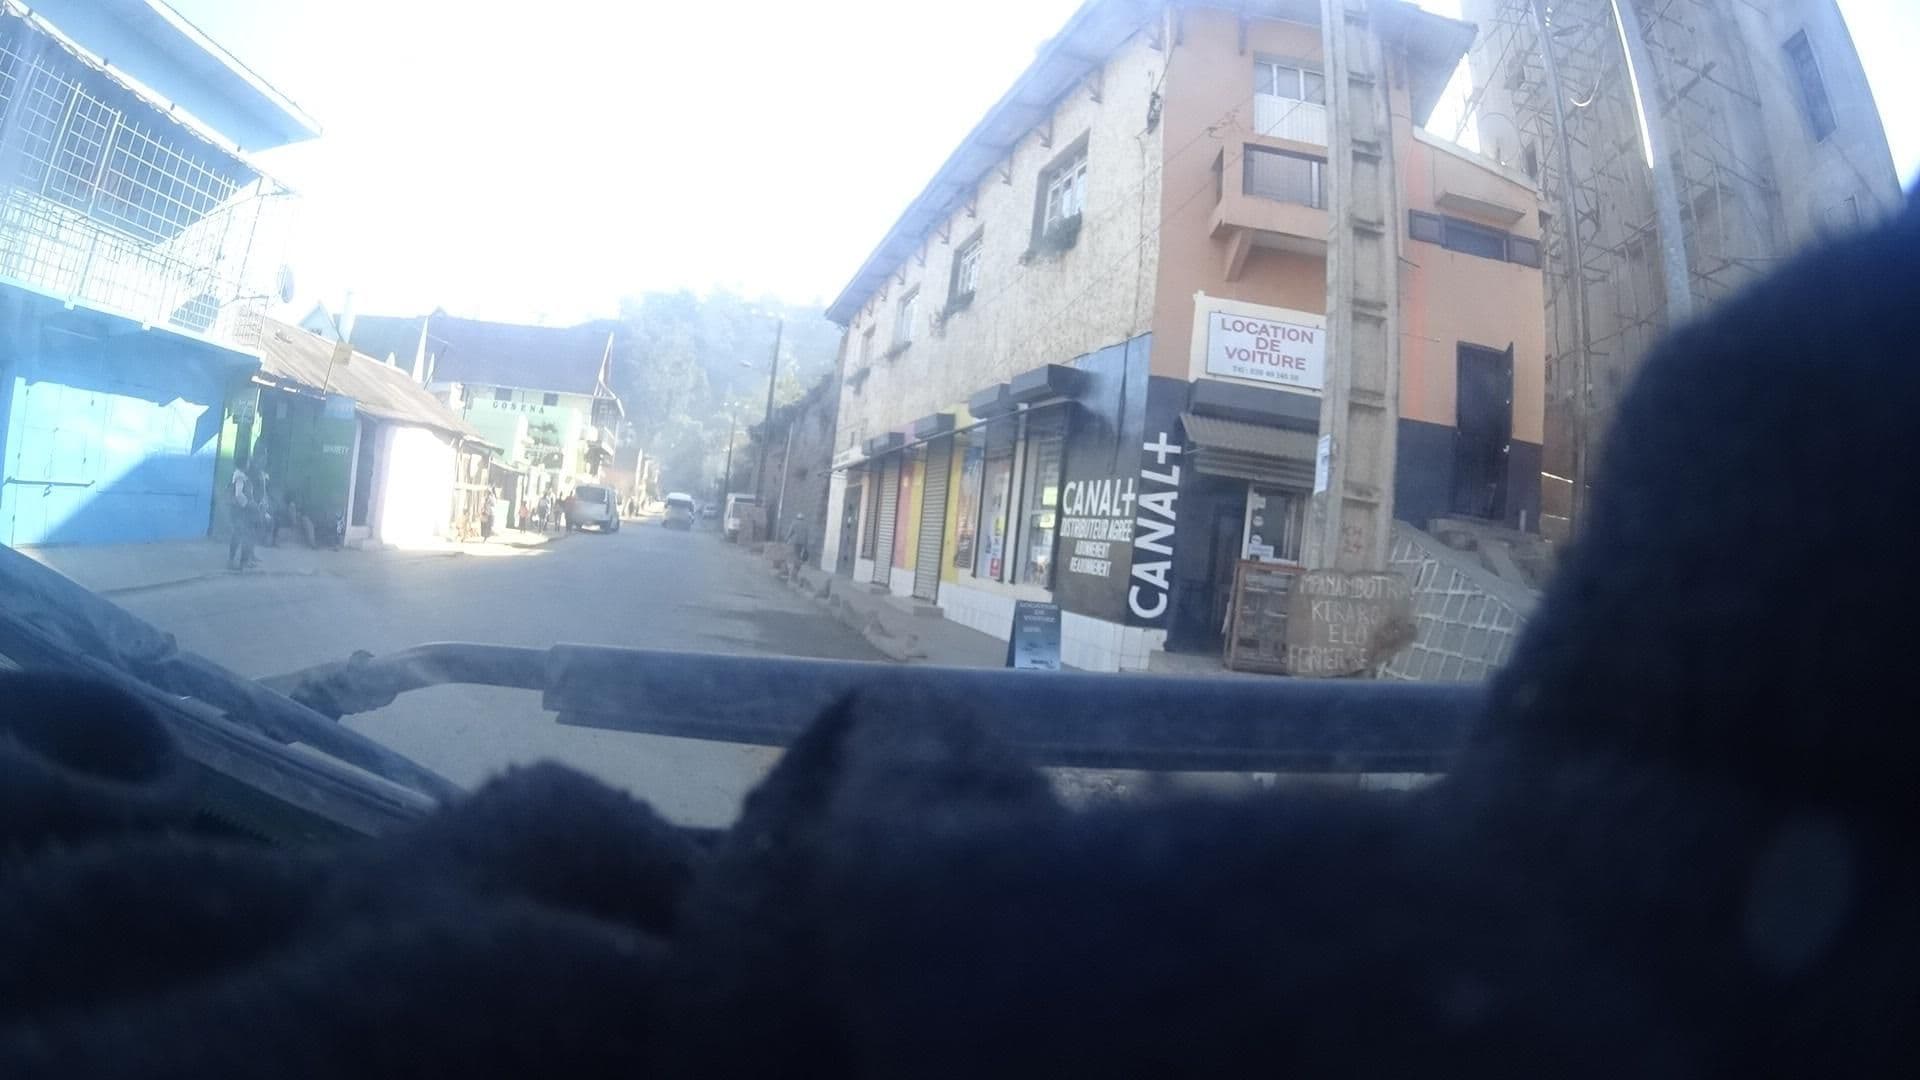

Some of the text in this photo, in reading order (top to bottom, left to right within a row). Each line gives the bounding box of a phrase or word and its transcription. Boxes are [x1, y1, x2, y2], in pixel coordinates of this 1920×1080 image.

[1221, 318, 1314, 344] LOCATION
[1225, 345, 1306, 371] VOITURE
[1255, 337, 1281, 353] DE
[1063, 477, 1136, 516] CANAL+
[1128, 432, 1182, 618] CANAL+
[1328, 623, 1369, 645] ELO
